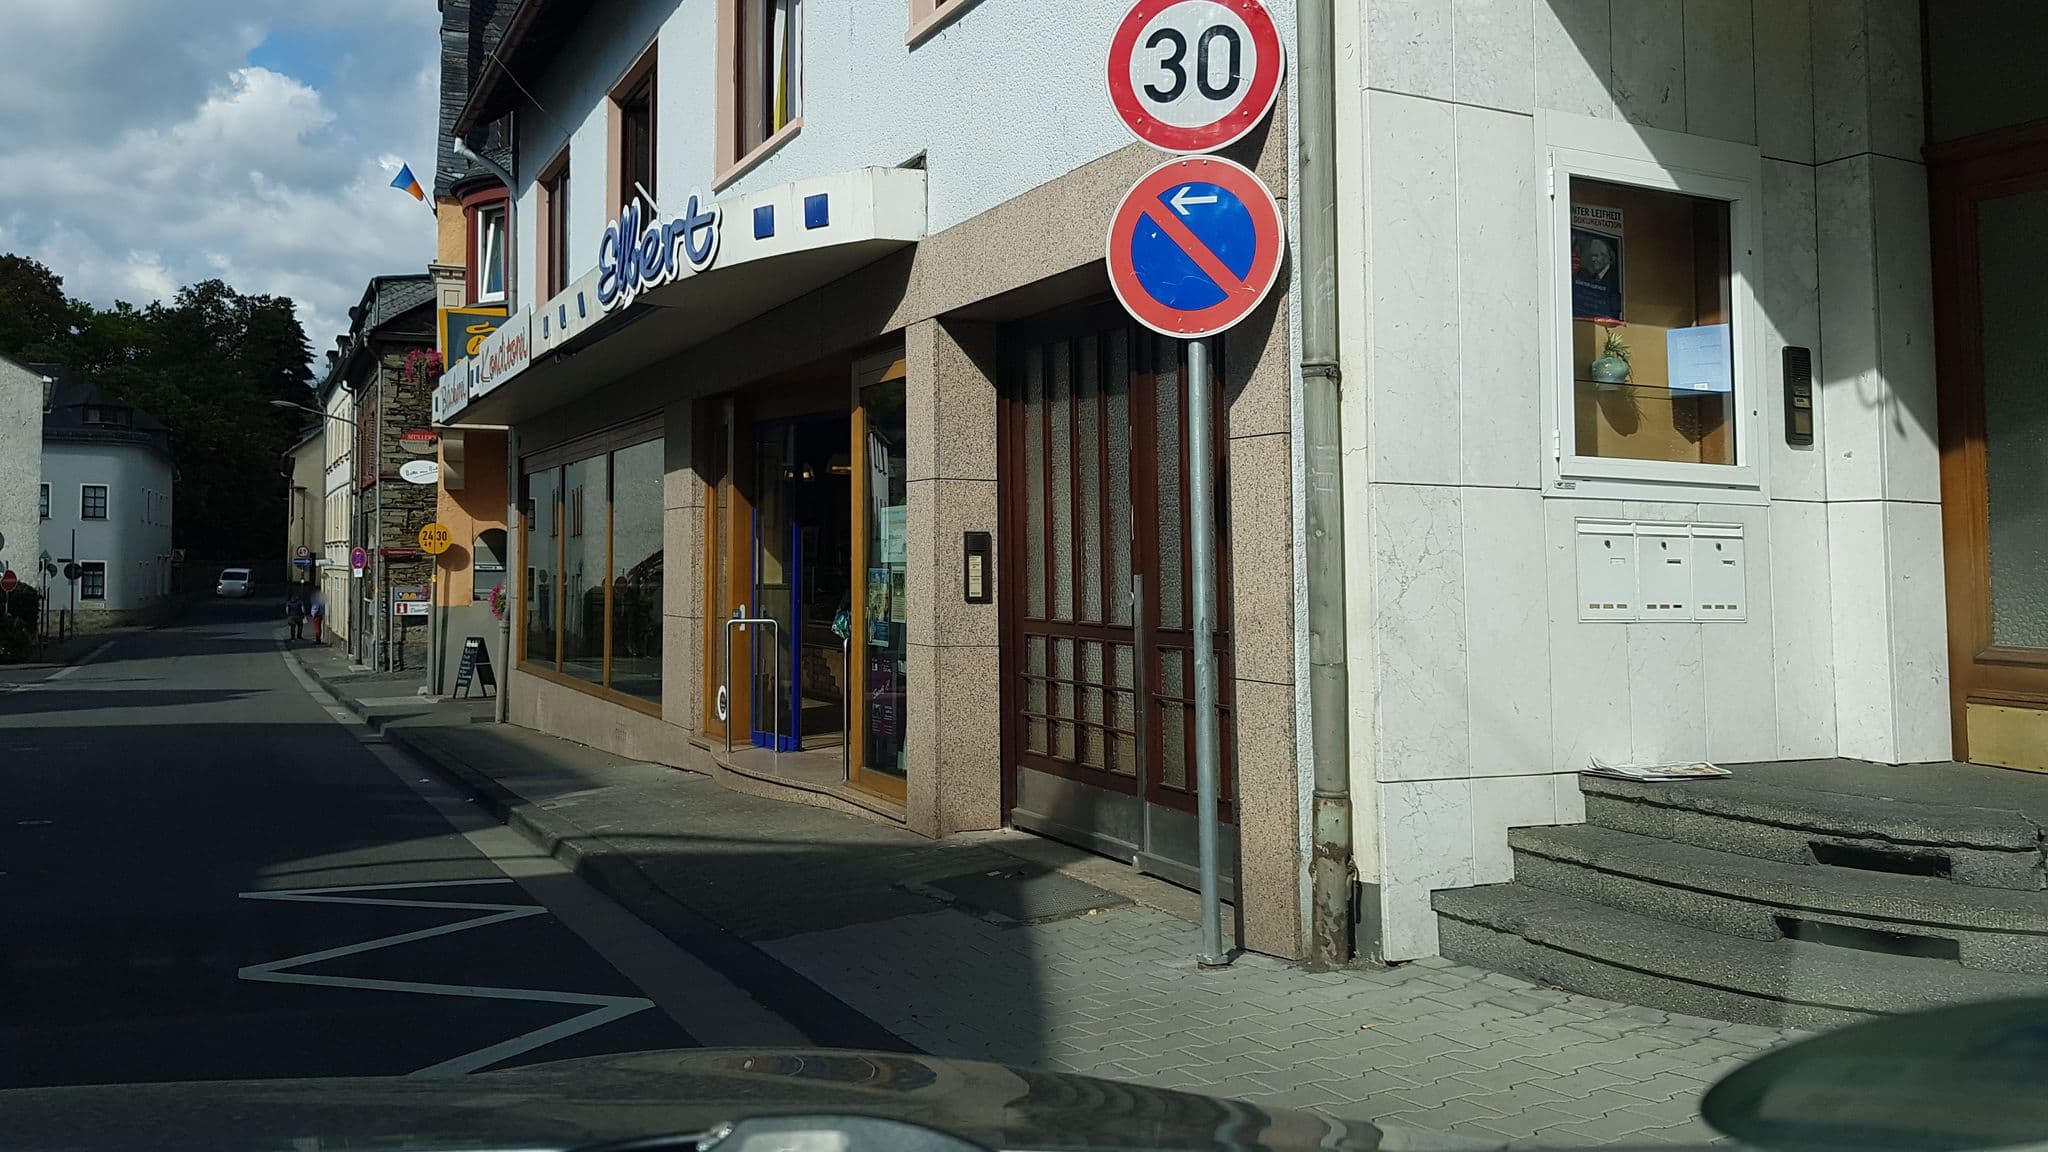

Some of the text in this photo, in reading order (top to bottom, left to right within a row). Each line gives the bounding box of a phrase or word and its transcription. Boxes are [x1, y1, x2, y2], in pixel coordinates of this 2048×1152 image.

[1143, 24, 1241, 104] 30
[598, 194, 718, 307] Elbert
[422, 530, 447, 541] 24 30
